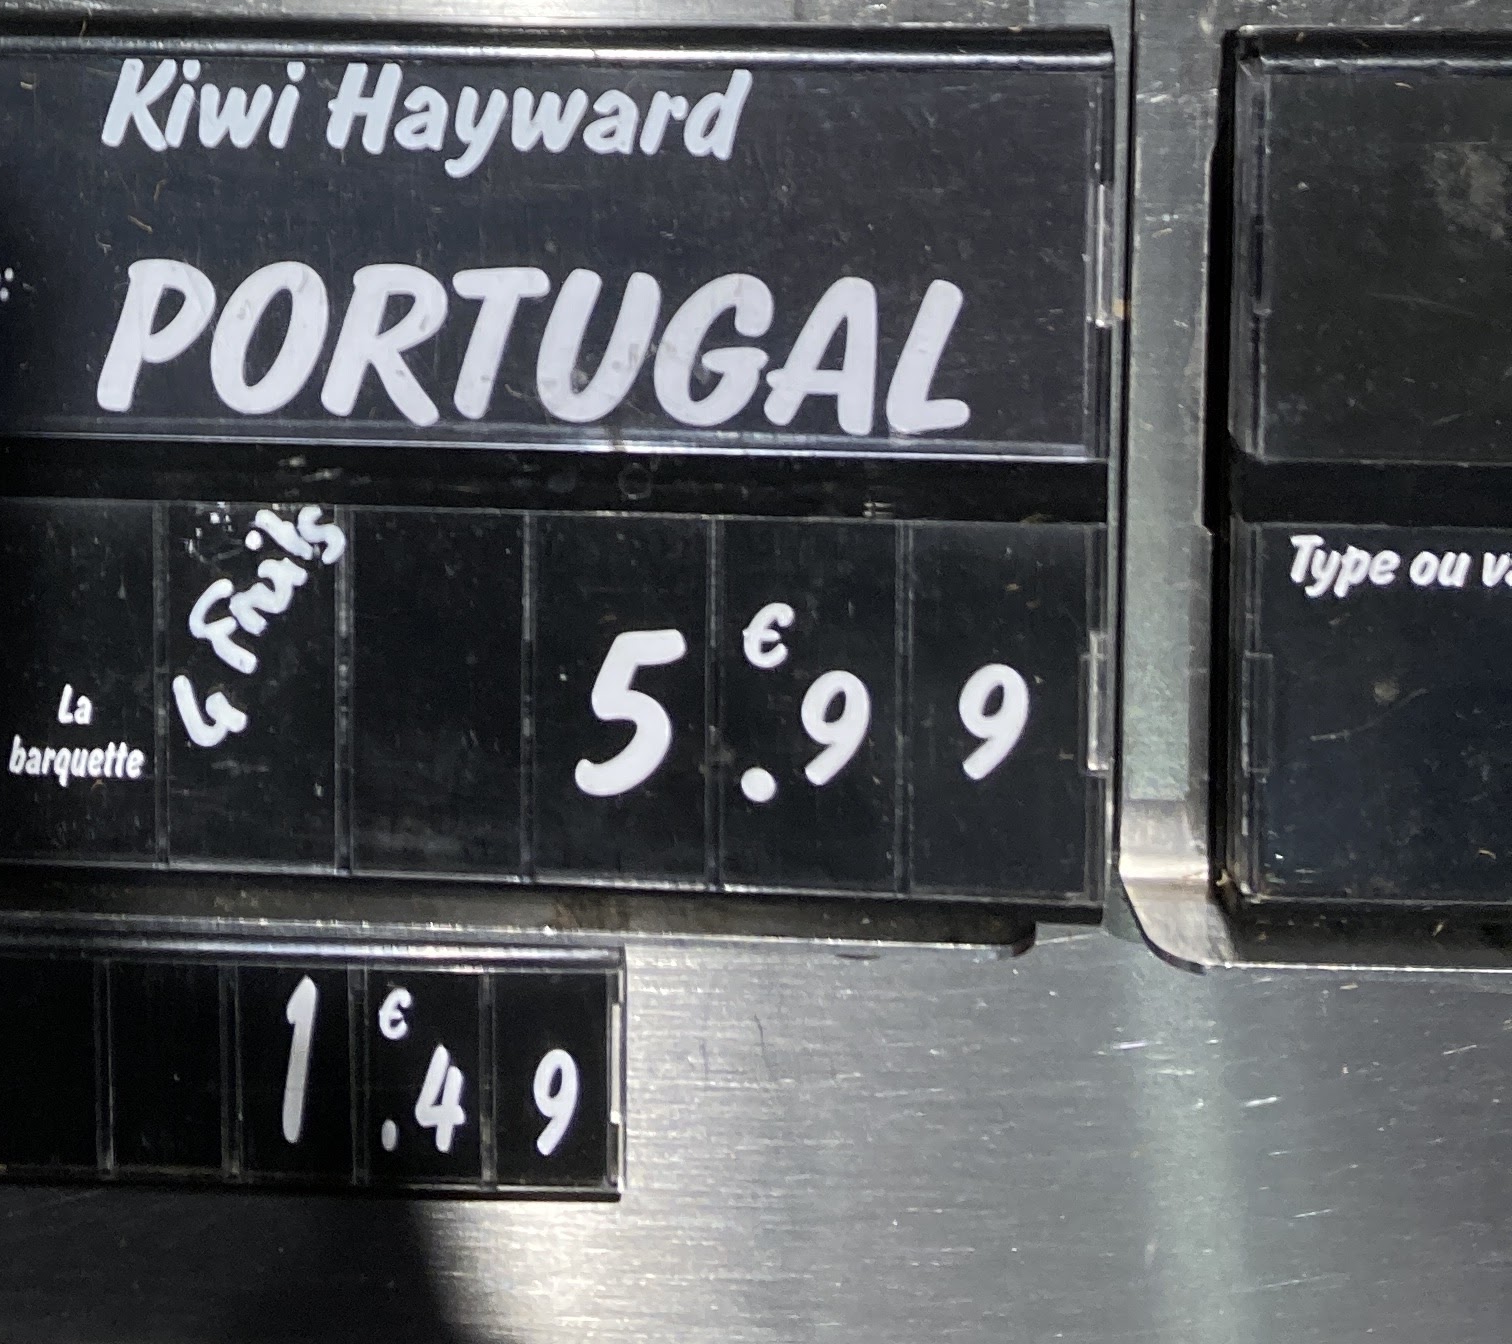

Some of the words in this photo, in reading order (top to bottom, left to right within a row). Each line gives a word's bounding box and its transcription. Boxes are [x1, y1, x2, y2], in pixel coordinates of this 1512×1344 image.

[101, 58, 303, 151] Kiwi
[326, 62, 753, 178] Hayward
[96, 258, 971, 436] PORTUGAL
[1290, 534, 1401, 598] Type
[1409, 551, 1471, 587] ou
[1482, 552, 1512, 587] v
[58, 684, 92, 726] La
[8, 734, 145, 788] barquette
